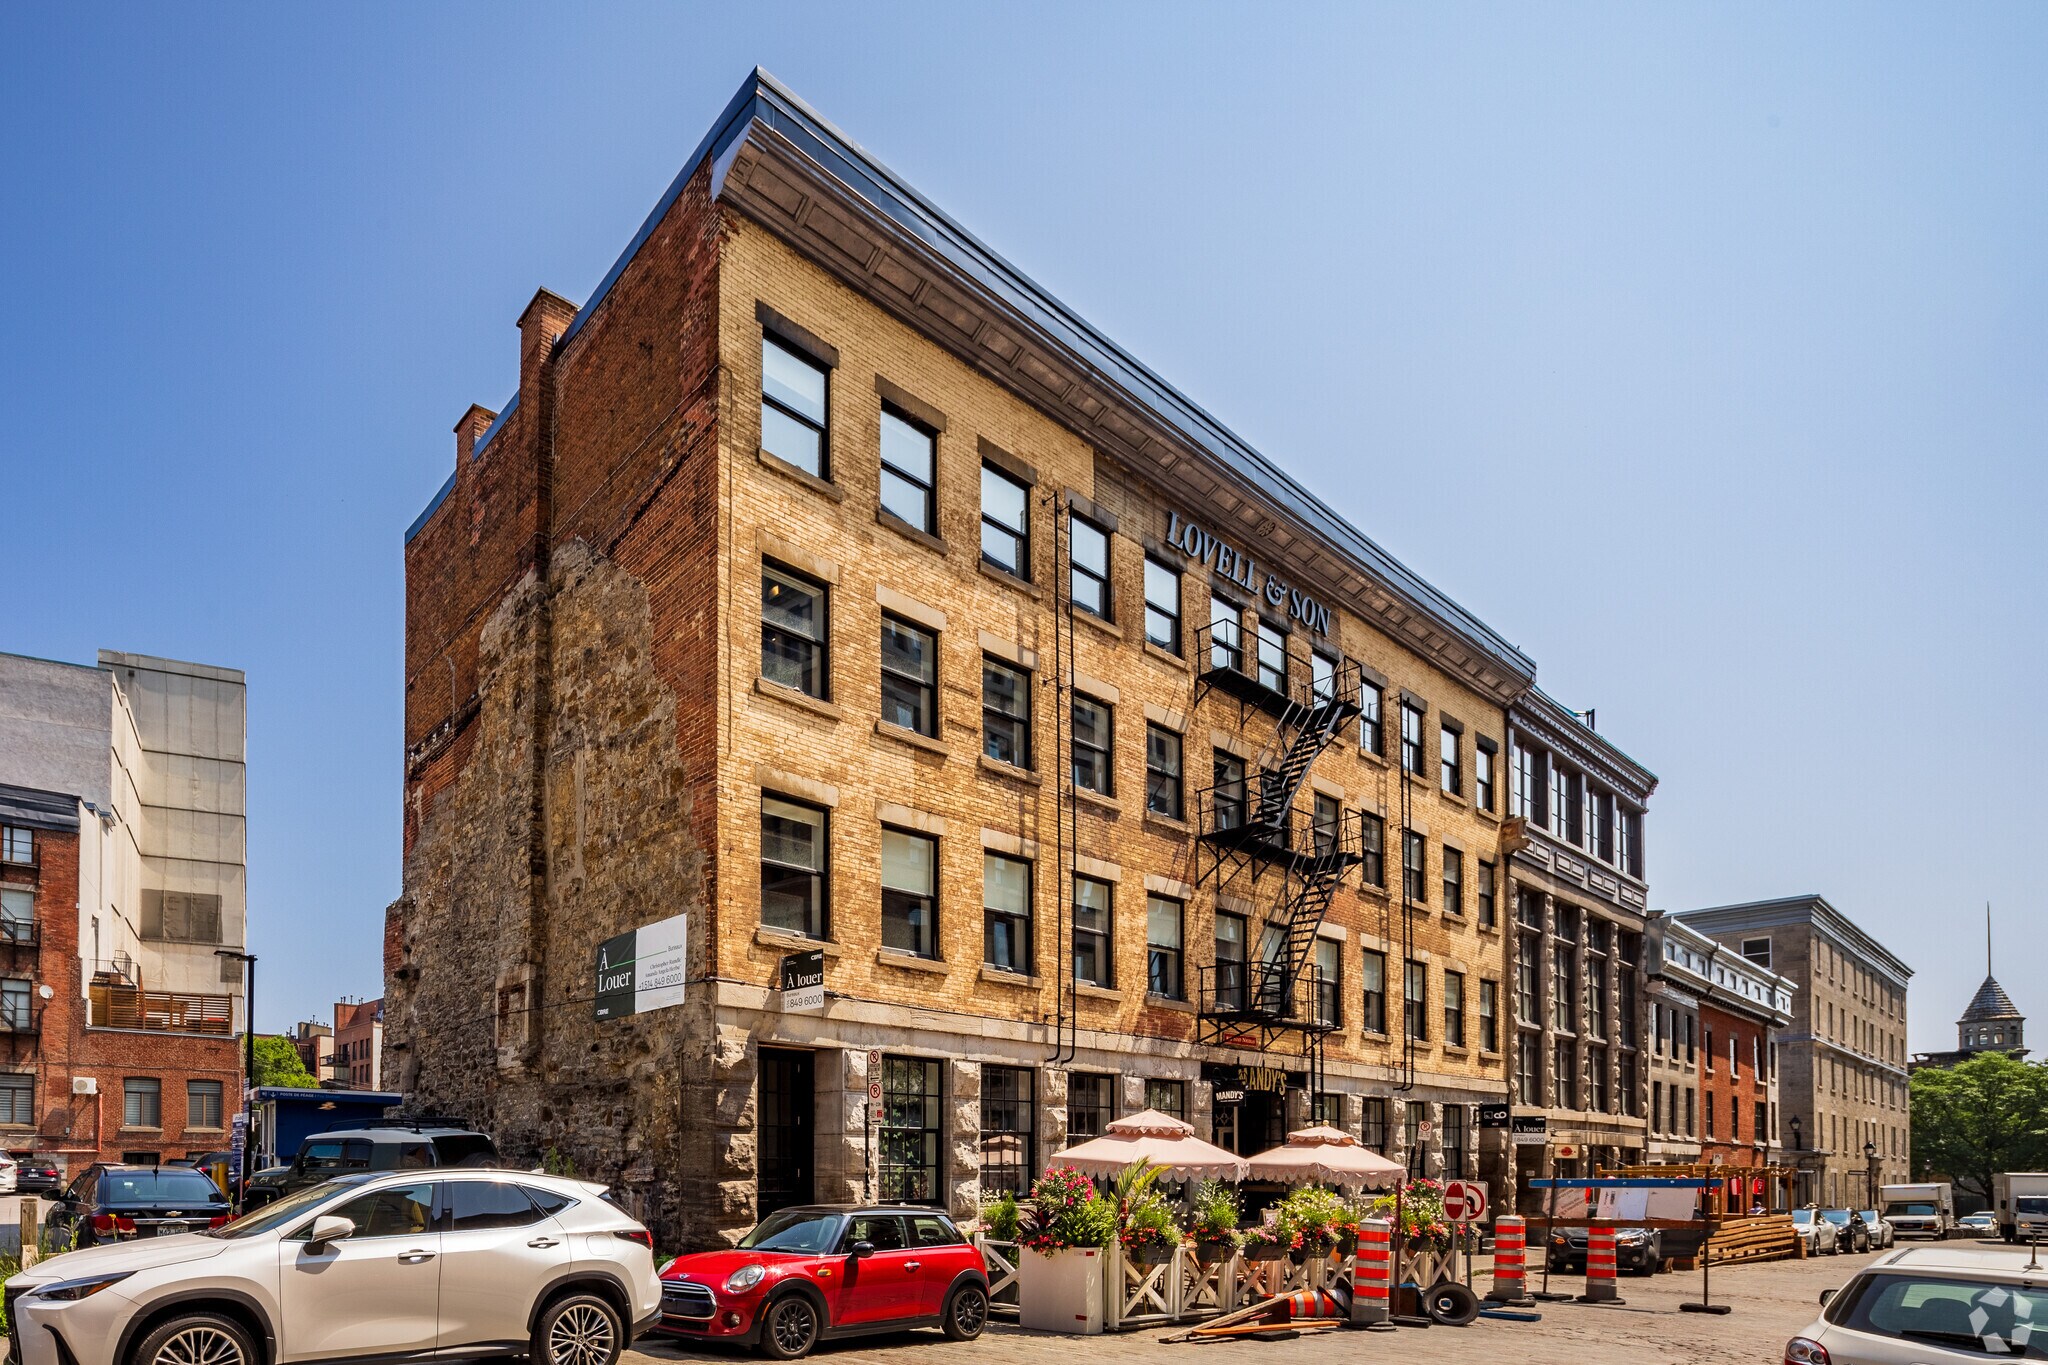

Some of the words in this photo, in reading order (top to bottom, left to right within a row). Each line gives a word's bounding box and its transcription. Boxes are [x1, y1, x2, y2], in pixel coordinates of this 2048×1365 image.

[1166, 510, 1259, 596] LOVELL
[1265, 574, 1288, 607] &
[1289, 587, 1332, 638] SON
[598, 947, 609, 972] À
[598, 971, 632, 993] Louer
[654, 976, 665, 987] 849
[666, 972, 682, 985] 6000
[786, 972, 795, 989] À
[797, 972, 823, 987] louer
[790, 997, 803, 1008] 849
[804, 994, 823, 1005] 6000
[1238, 1066, 1287, 1096] MANDY'S
[1215, 1090, 1244, 1101] MANDY'S
[1514, 1124, 1521, 1133] À
[1523, 1125, 1545, 1133] louer
